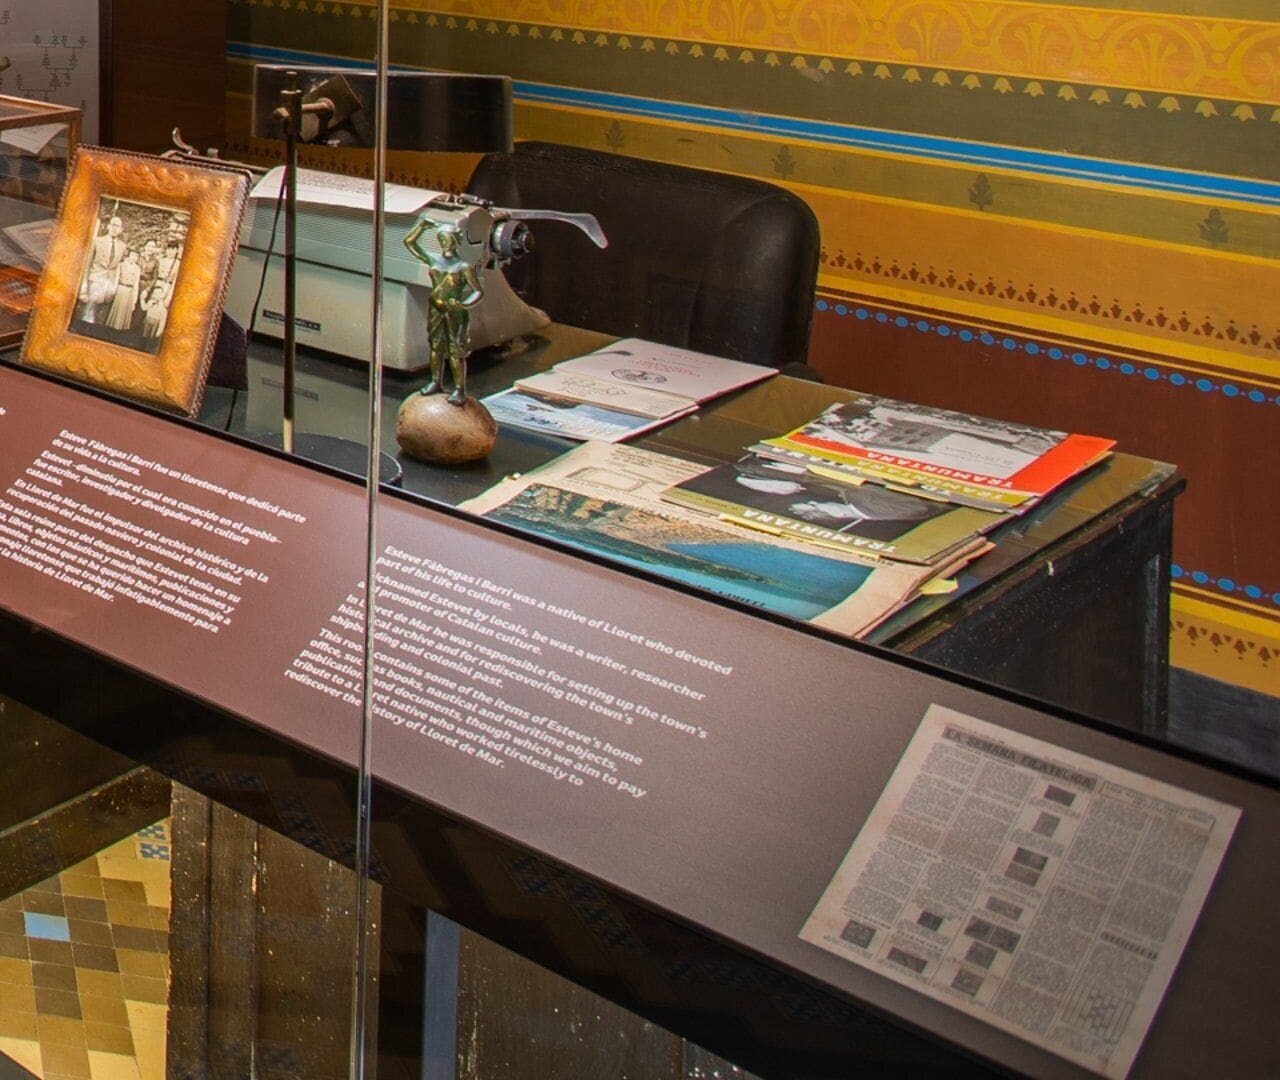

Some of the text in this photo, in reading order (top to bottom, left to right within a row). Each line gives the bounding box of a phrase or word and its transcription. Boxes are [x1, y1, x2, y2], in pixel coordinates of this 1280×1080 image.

[57, 429, 89, 445] Esteve
[85, 439, 129, 461] Fàbregas
[128, 454, 156, 469] Barri
[151, 462, 171, 474] fue
[166, 469, 182, 479] un
[179, 472, 230, 495] lloretense
[224, 490, 247, 503] que
[244, 495, 280, 514] dedicó
[275, 507, 307, 525] parte
[867, 451, 1013, 488] TRAMUNTANA
[742, 508, 896, 554] TRAMUNTANA
[372, 554, 515, 610] part of his life to culture.
[382, 546, 423, 565] Esteve
[418, 559, 476, 586] Fàbregas
[479, 579, 513, 597] Barri
[510, 591, 537, 606] was
[545, 602, 589, 623] native
[586, 616, 605, 629] of
[602, 621, 646, 643] Lloret
[643, 636, 676, 654] who
[673, 646, 734, 674] devoted
[376, 587, 545, 655] promoter of Catalan culture.
[427, 592, 474, 615] Estevet
[470, 608, 491, 623] by
[486, 614, 532, 638] locals,
[530, 629, 550, 643] he
[547, 637, 576, 652] was
[582, 649, 628, 673] writer,
[629, 665, 708, 700] researcher
